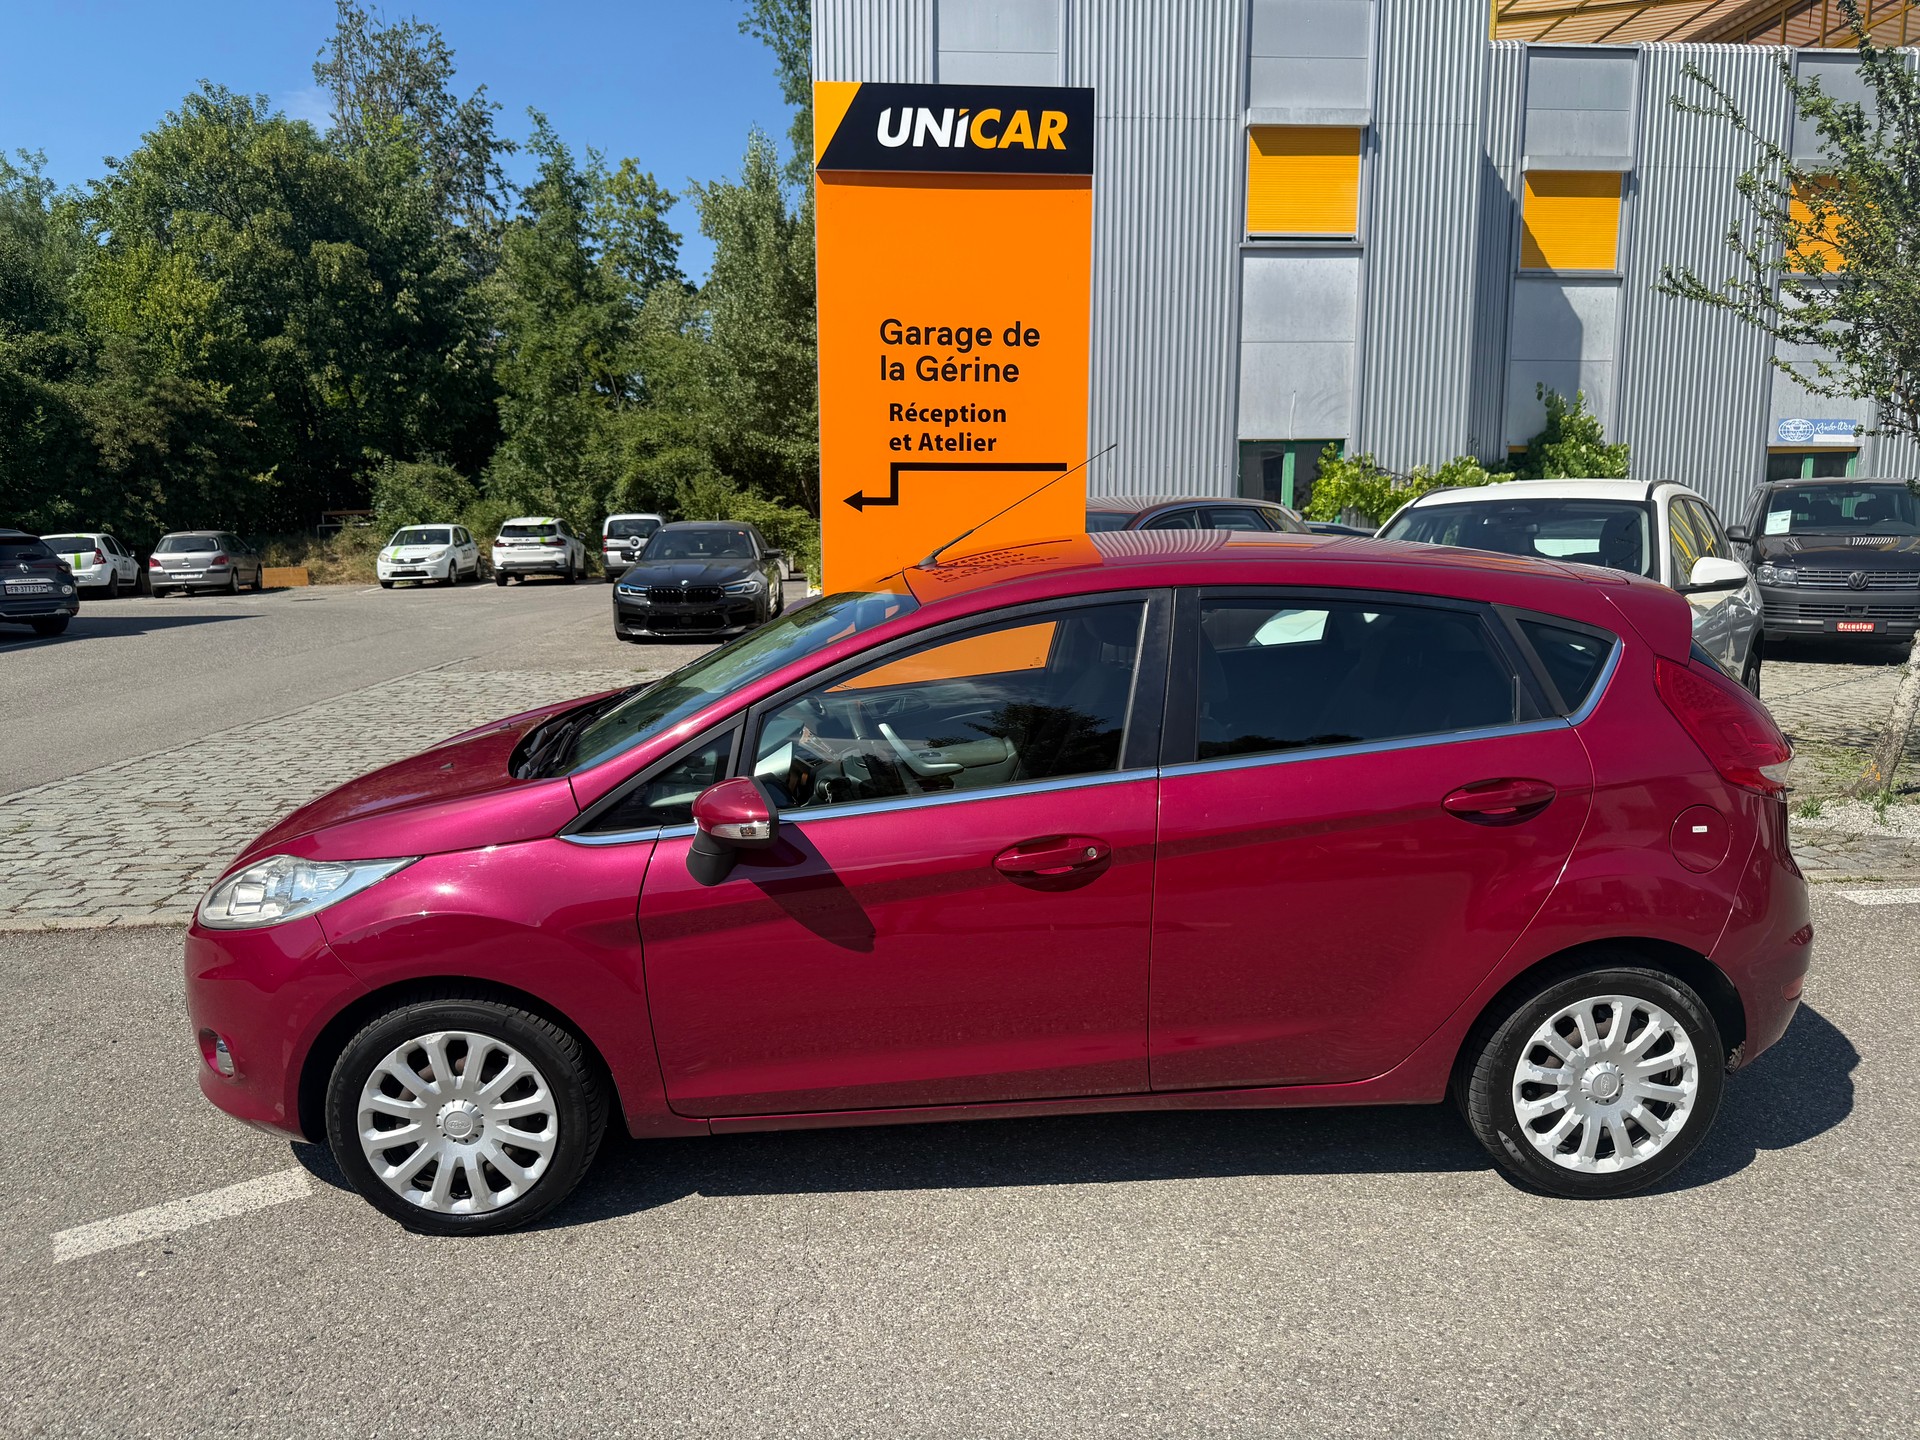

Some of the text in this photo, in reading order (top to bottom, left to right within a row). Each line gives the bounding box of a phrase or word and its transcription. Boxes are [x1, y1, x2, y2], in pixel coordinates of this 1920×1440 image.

[879, 318, 1040, 353] Garage de
[880, 354, 1019, 383] la Gérine
[889, 402, 1007, 427] Réception
[889, 432, 997, 451] et Atelier
[1838, 622, 1872, 630] Occasion
